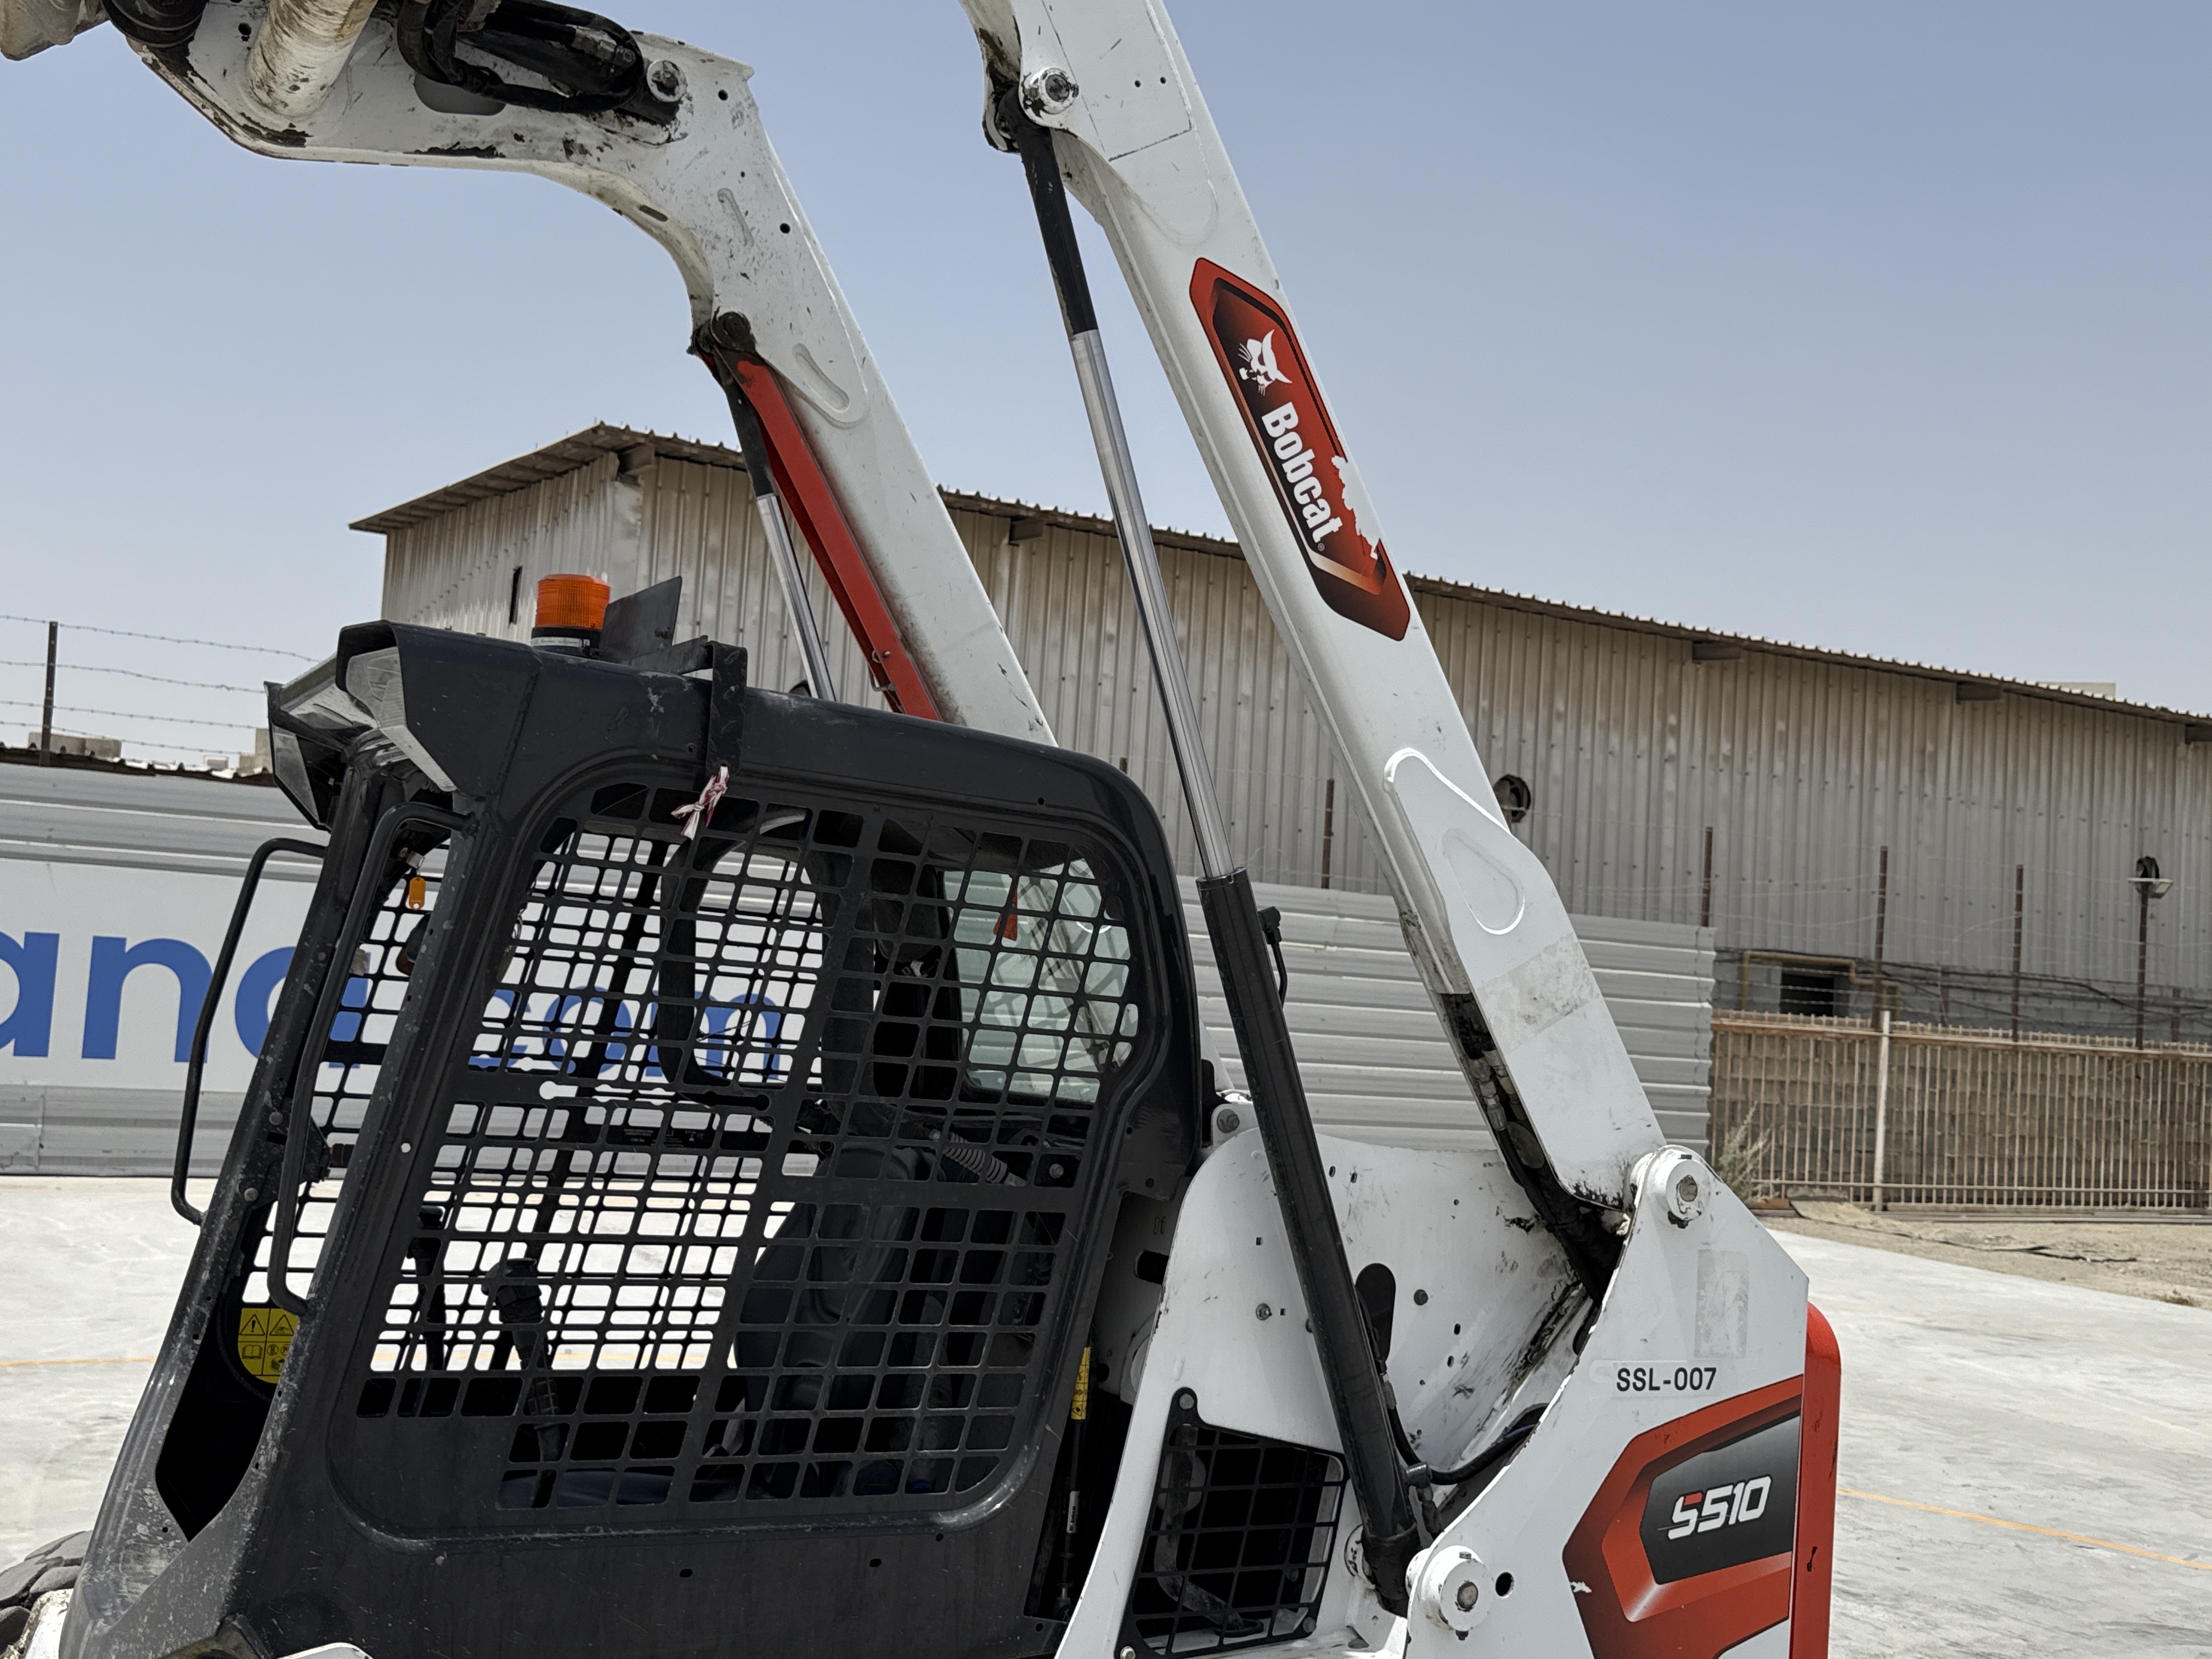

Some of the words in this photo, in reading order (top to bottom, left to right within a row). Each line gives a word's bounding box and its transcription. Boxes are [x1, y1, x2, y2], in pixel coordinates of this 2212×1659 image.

[1261, 402, 1342, 543] Bobcat
[1616, 1367, 1717, 1391] SSL-007
[1667, 1475, 1771, 1539] S510
